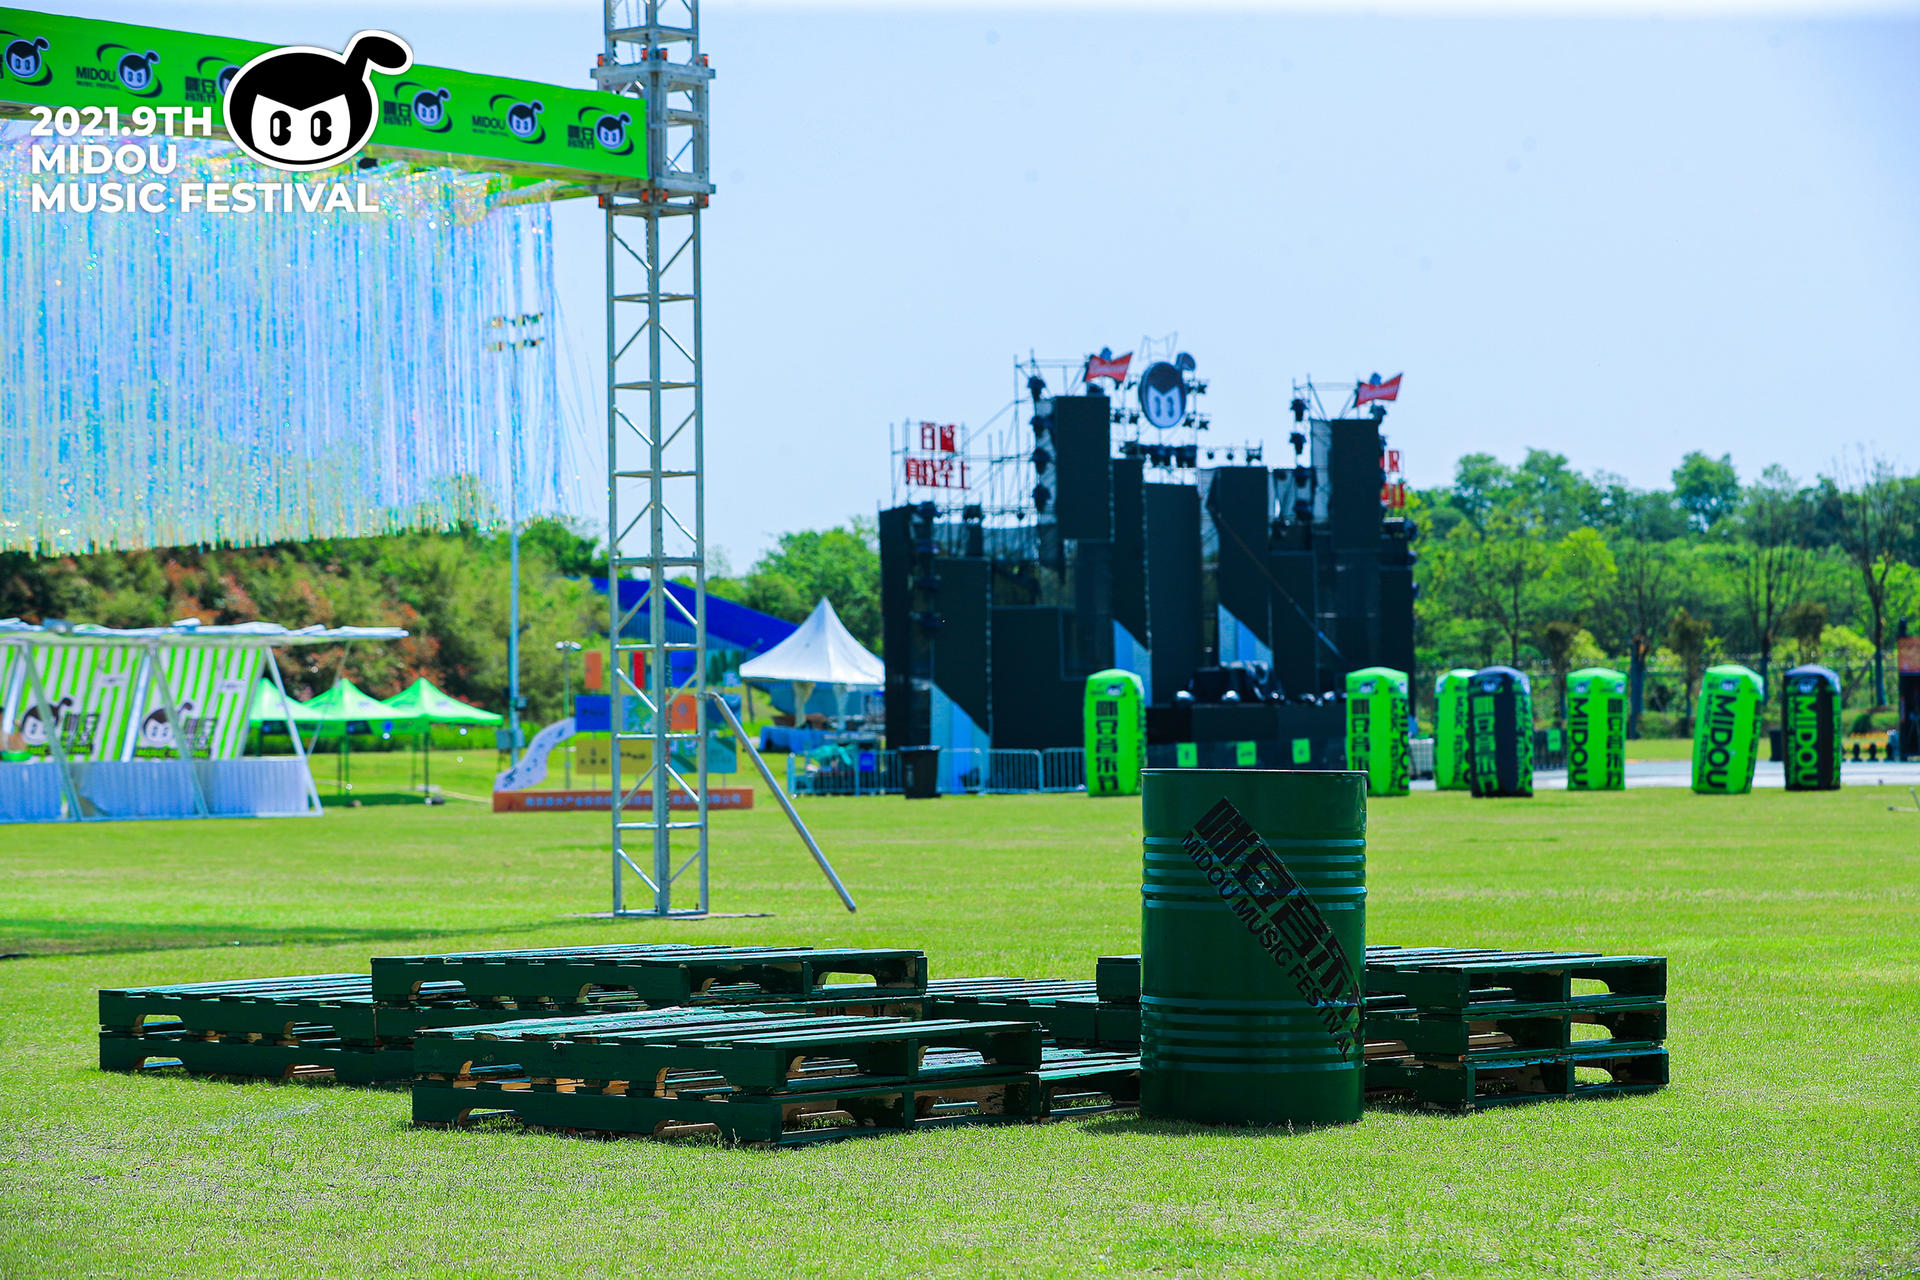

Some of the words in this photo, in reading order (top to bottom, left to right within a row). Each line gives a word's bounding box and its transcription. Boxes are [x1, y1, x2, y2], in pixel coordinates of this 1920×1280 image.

[76, 66, 116, 83] MIDOU
[473, 115, 506, 130] MIDOU
[1572, 697, 1588, 786] MIDOU
[1706, 695, 1736, 789] MIDOU
[1795, 695, 1818, 787] MIDOU
[1181, 832, 1238, 900] MIDOU
[1232, 899, 1292, 967] MUSIC
[1287, 964, 1347, 1061] FESTIVAL
